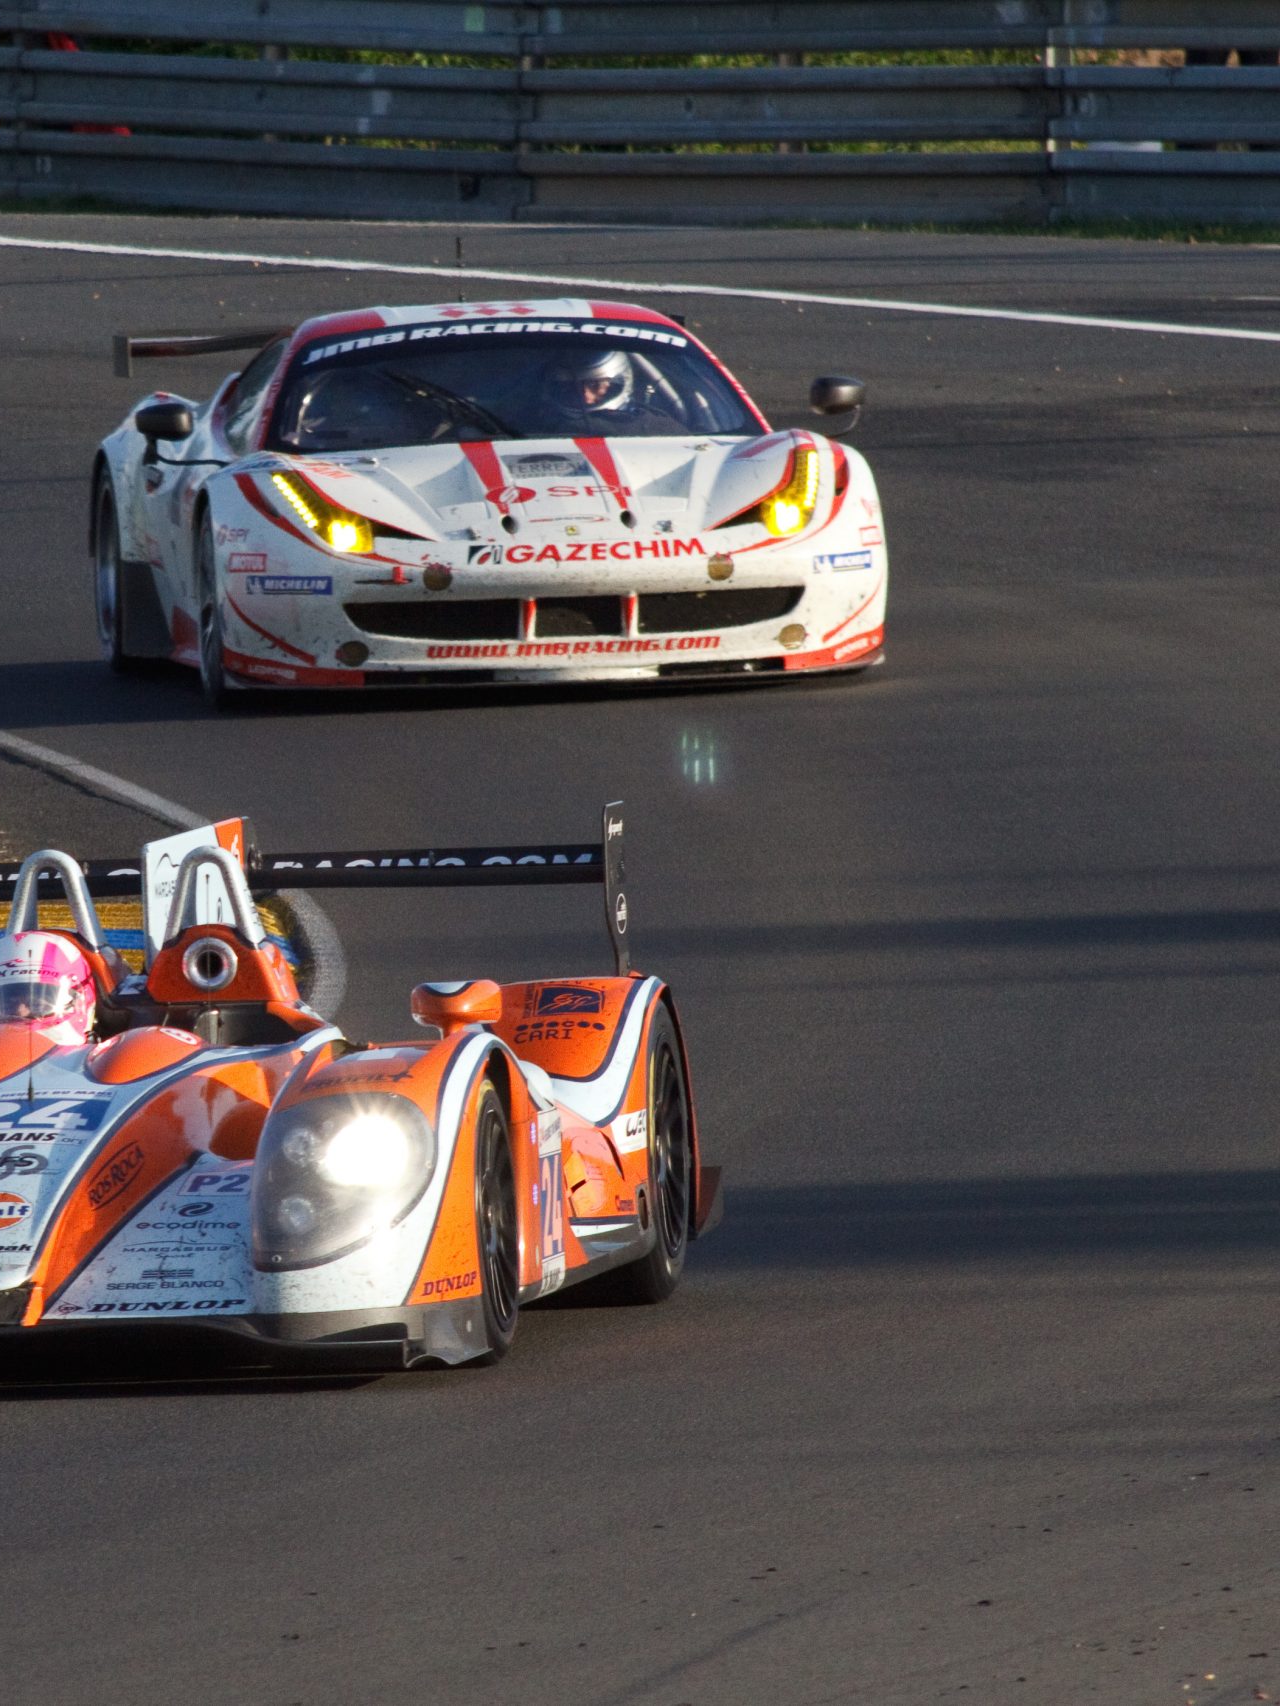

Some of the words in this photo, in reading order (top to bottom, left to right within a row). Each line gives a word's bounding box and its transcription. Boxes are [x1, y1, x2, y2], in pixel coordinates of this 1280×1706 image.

[303, 331, 406, 366] JMB
[505, 538, 705, 564] GAZECHIM
[263, 578, 329, 590] MICHELIN
[10, 968, 60, 979] racing
[513, 1028, 574, 1045] CARI
[186, 1173, 251, 1193] P2
[540, 1154, 563, 1259] 24
[136, 1219, 241, 1230] ecodime
[106, 1281, 156, 1290] SERGE
[160, 1280, 225, 1289] BLANCO
[422, 1270, 478, 1297] DUNLOP
[87, 1299, 247, 1313] DUNLOP
